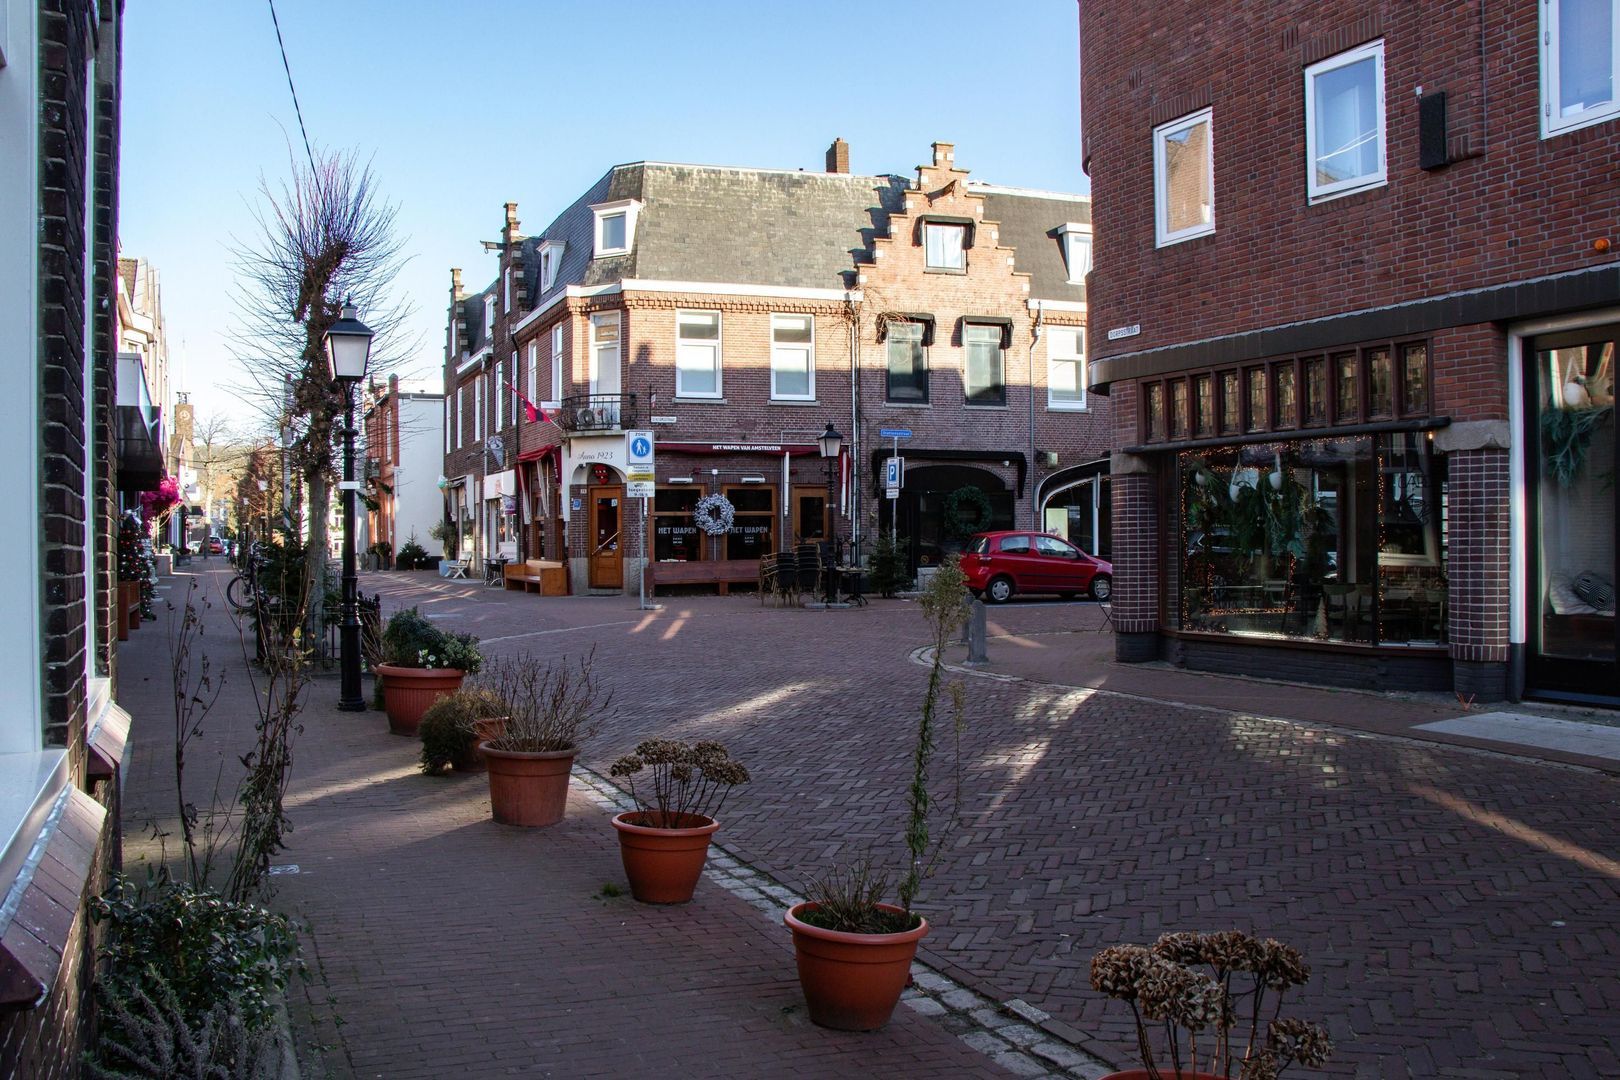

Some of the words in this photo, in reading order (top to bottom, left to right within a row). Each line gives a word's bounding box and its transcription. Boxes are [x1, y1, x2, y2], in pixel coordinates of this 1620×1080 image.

[577, 451, 595, 460] Anno
[597, 451, 614, 460] 1923
[730, 526, 743, 534] HET
[744, 526, 768, 534] WAPEN
